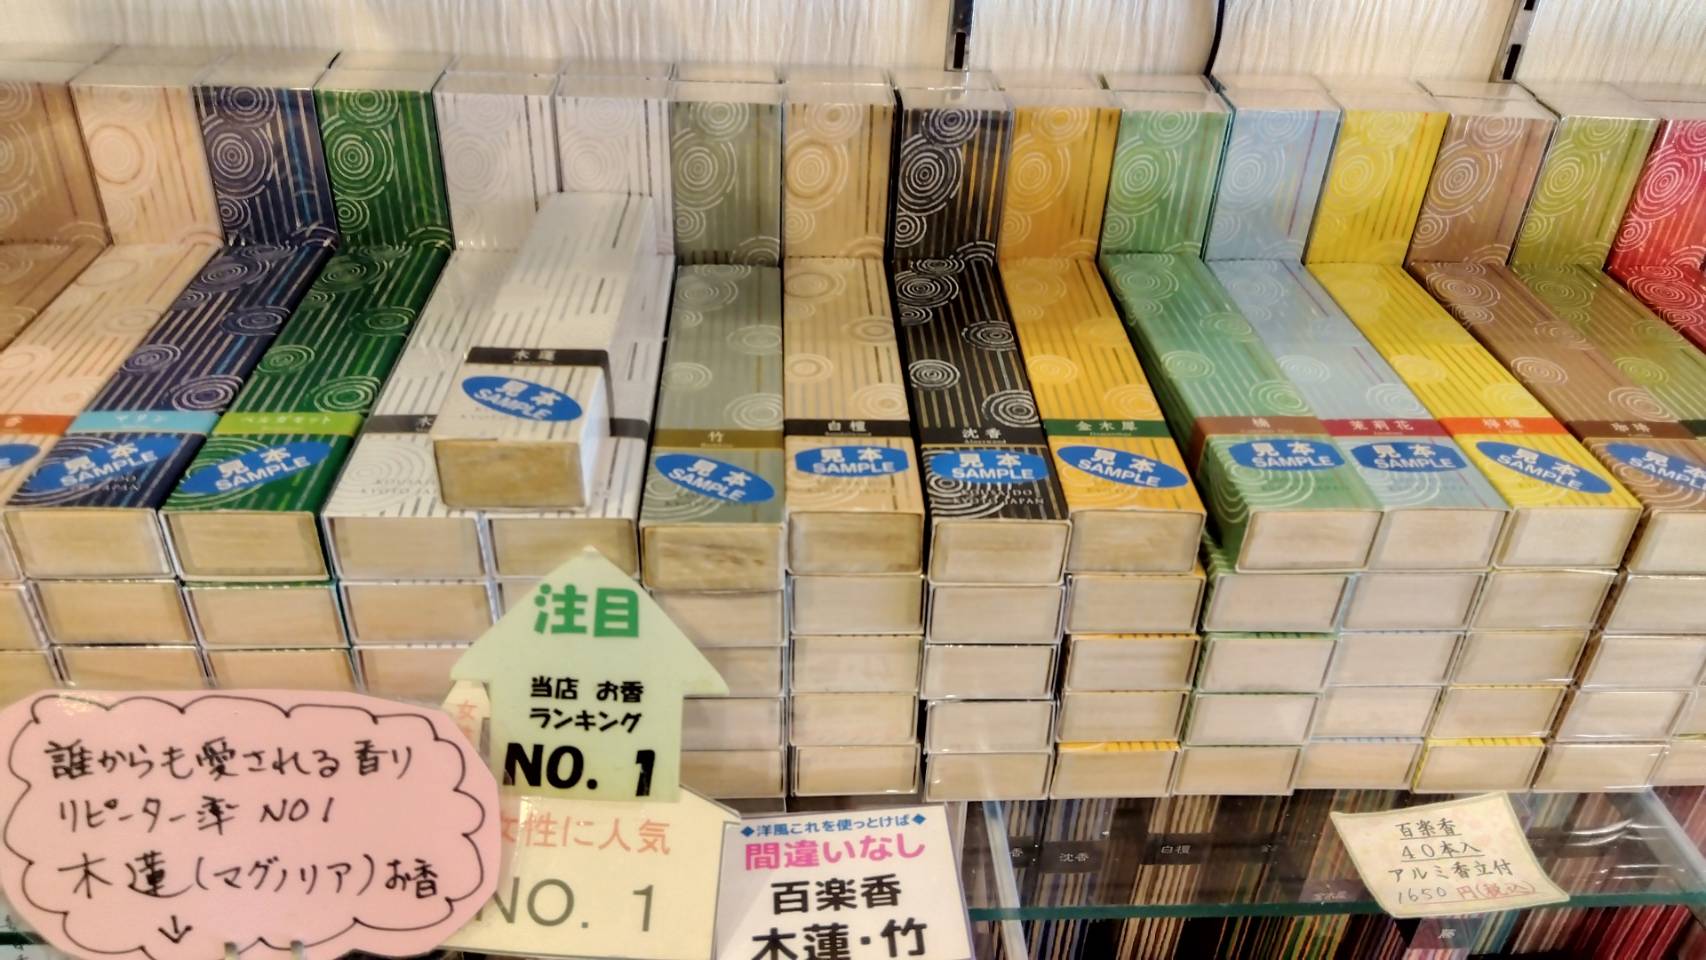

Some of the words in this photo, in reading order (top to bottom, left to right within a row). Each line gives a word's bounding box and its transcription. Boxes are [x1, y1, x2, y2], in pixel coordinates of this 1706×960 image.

[474, 388, 552, 420] SAMPLE
[495, 380, 561, 406] 見本
[708, 431, 724, 442] 竹
[1251, 441, 1315, 456] 見本
[65, 443, 139, 474] 見本
[218, 447, 291, 478] 見本
[821, 447, 883, 463] 見本
[960, 453, 1021, 468] 見本
[1091, 448, 1156, 473] 見本
[1252, 456, 1335, 468] SAMPLE
[1372, 444, 1436, 458] 見本
[1374, 458, 1456, 468] SAMPLE
[1512, 448, 1580, 477] 見本
[60, 450, 158, 487] SAMPLE
[215, 456, 310, 490] SAMPLE
[687, 459, 752, 487] 見本
[813, 461, 896, 473] SAMPLE
[952, 468, 1035, 480] SAMPLE
[1078, 459, 1160, 487] SAMPLE
[1497, 454, 1583, 490] SAMPLE
[668, 468, 746, 501] SAMPLE
[534, 585, 638, 638] 注目
[530, 676, 578, 700] 当店
[596, 680, 643, 703] お香
[529, 707, 642, 733] ランキング
[503, 742, 598, 790] NO.
[635, 749, 655, 797] 1
[745, 833, 926, 871] 間違いなし
[1402, 840, 1482, 859] 40本入
[632, 884, 654, 932] 1
[771, 873, 902, 915] 百楽香
[751, 917, 928, 960] 木蓮・竹
